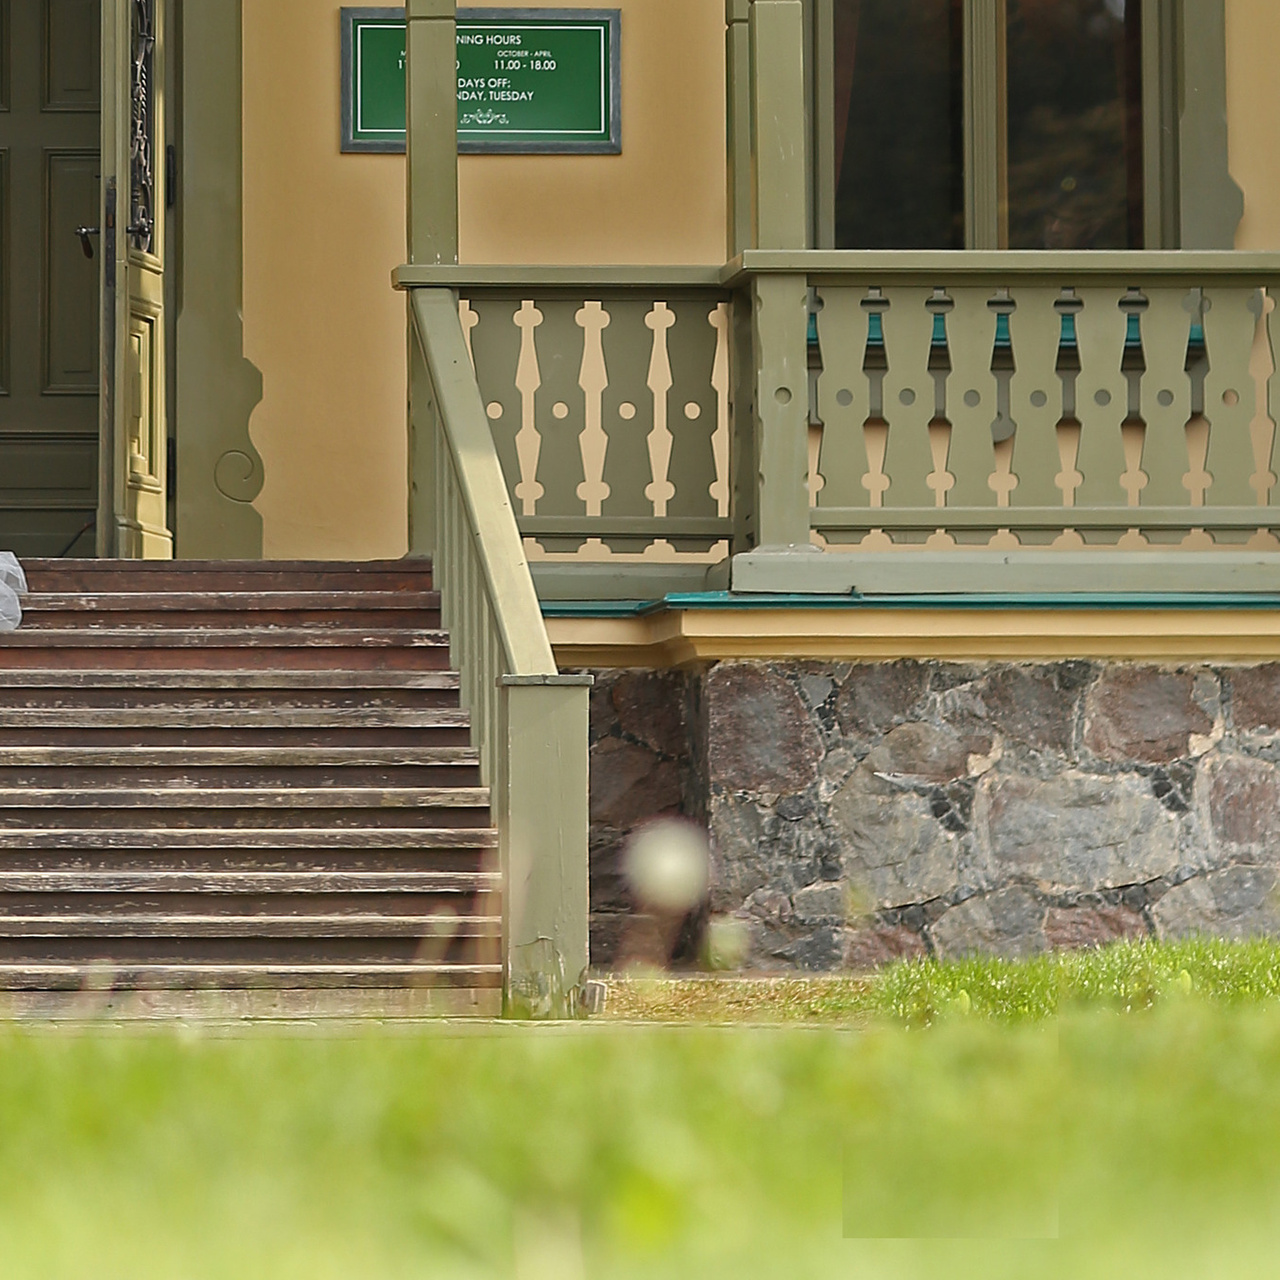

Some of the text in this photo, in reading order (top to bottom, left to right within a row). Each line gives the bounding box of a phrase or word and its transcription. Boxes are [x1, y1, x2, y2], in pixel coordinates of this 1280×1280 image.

[456, 34, 522, 45] NING HOURS
[497, 50, 529, 58] OCTOBER
[534, 50, 552, 58] APRIL
[494, 59, 521, 71] 11.00
[529, 59, 557, 71] 18.00
[458, 78, 511, 88] DAYS OFF:
[456, 90, 534, 102] NDAY, TUESDAY
